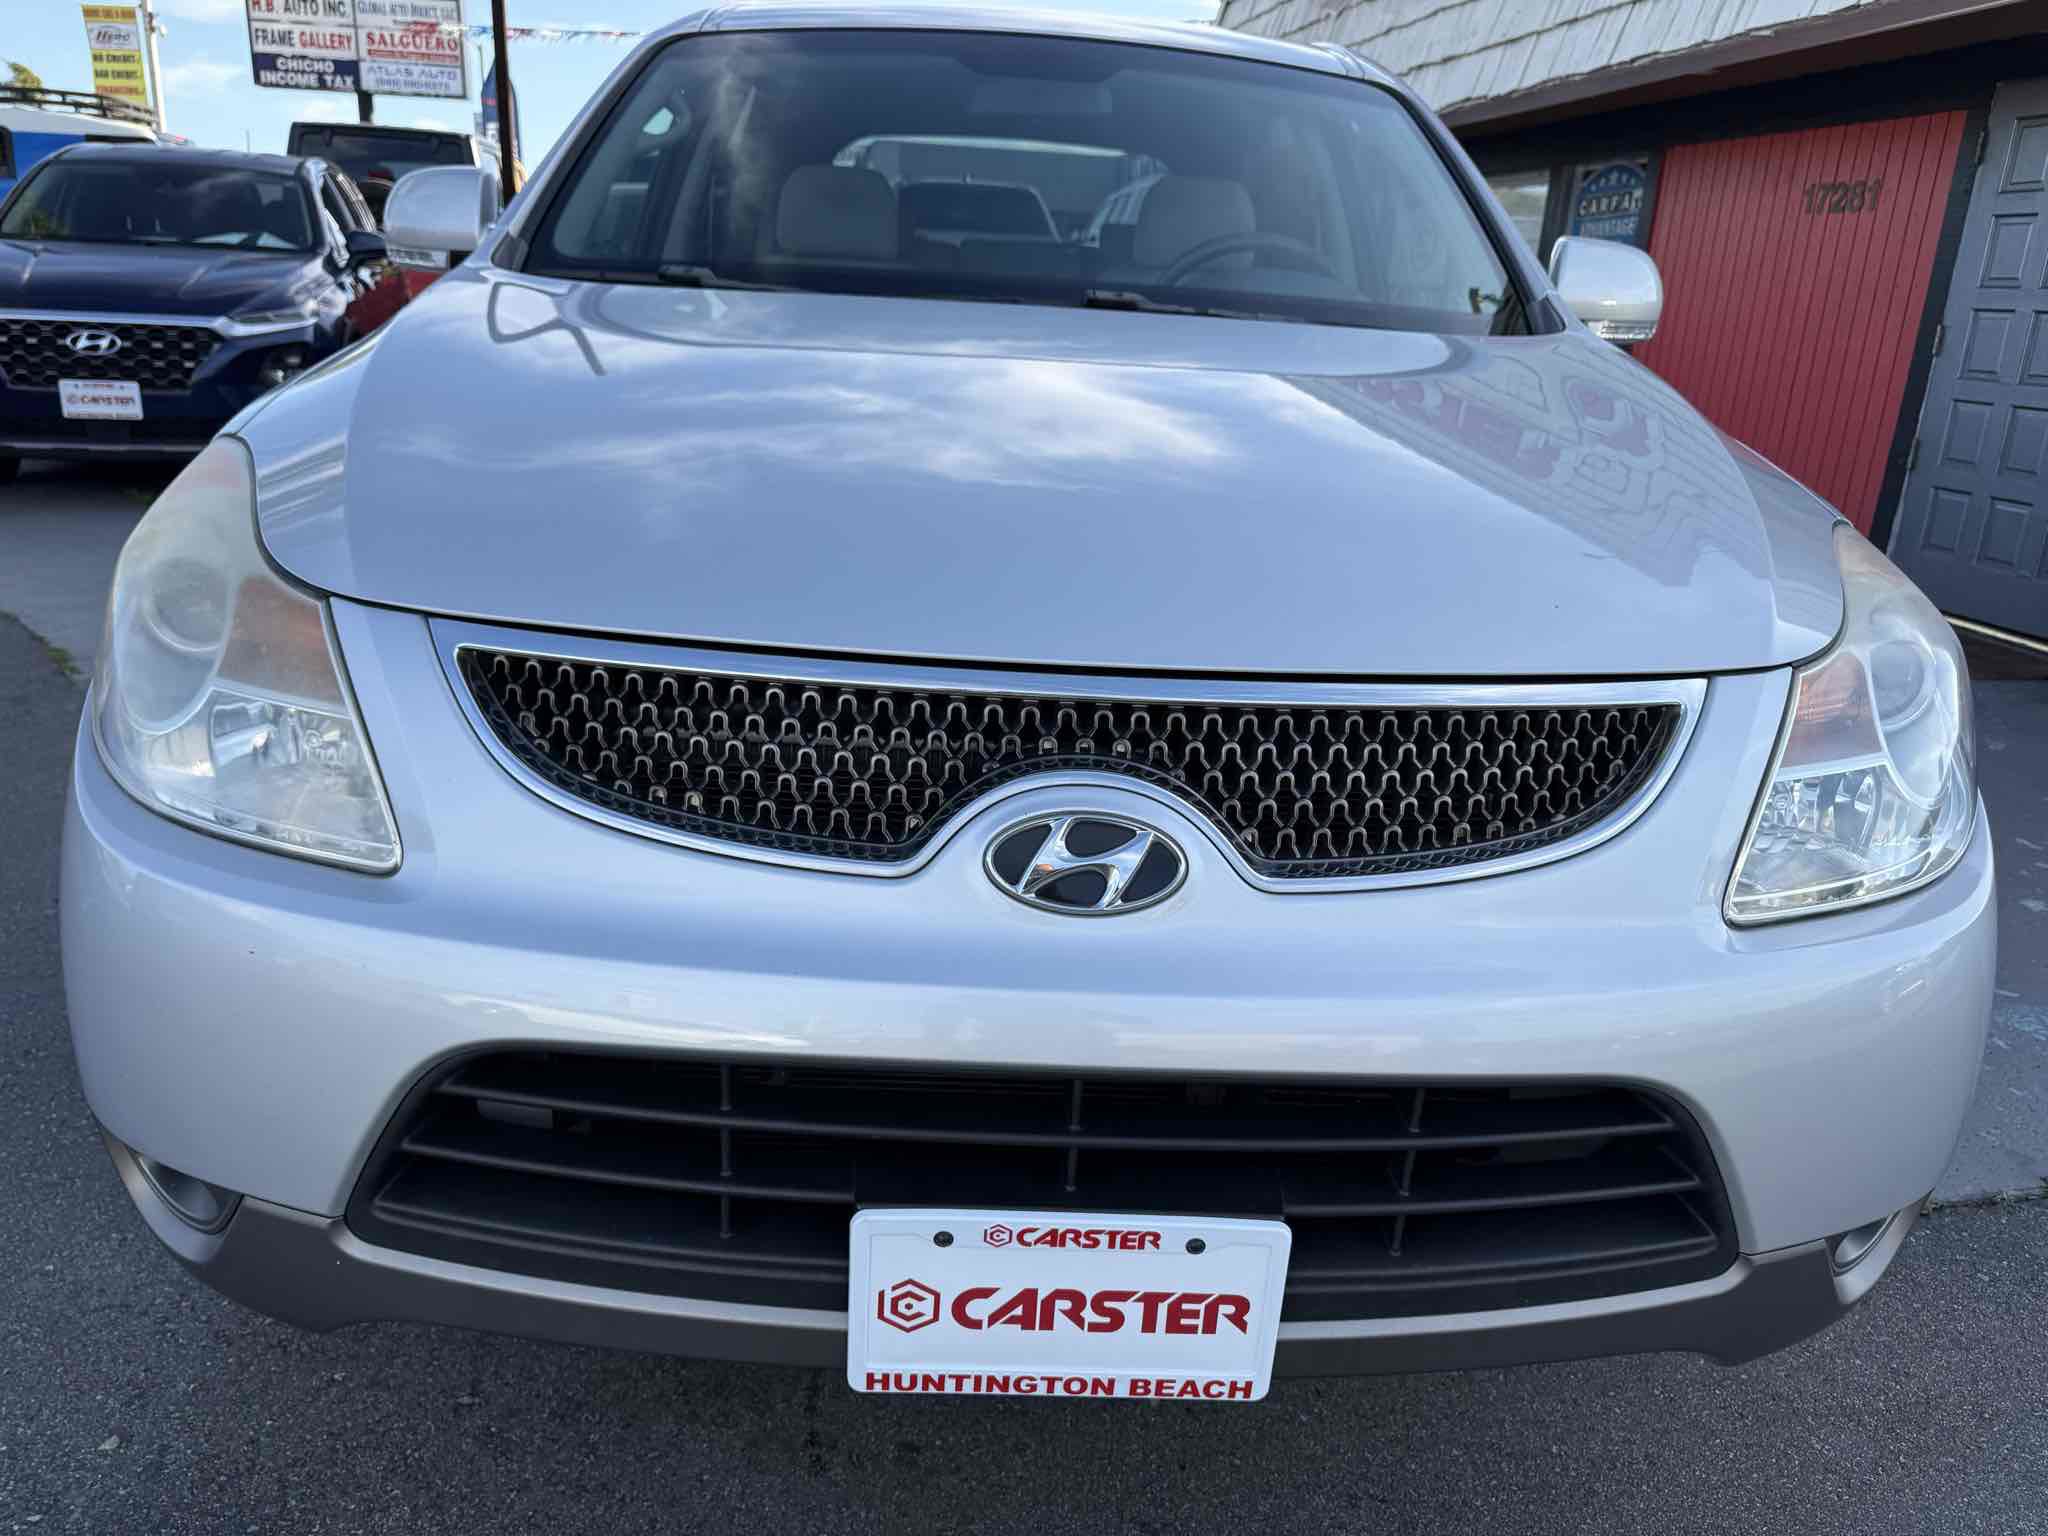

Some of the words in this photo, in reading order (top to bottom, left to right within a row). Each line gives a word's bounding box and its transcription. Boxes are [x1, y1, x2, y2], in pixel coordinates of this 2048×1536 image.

[284, 0, 318, 16] AUTO
[254, 28, 295, 47] FRAME
[299, 31, 353, 50] GALLERY
[367, 32, 458, 52] SALGUERO
[275, 56, 335, 74] CHICHO
[367, 64, 413, 77] ATLAS
[420, 67, 458, 81] AUTO
[260, 69, 320, 87] INCOME
[322, 74, 355, 92] TAX
[1016, 1226, 1162, 1250] CARSTER
[951, 1286, 1251, 1335] CARSTER
[865, 1371, 1116, 1396] HUNTINGTON
[1128, 1378, 1253, 1399] BEACH
